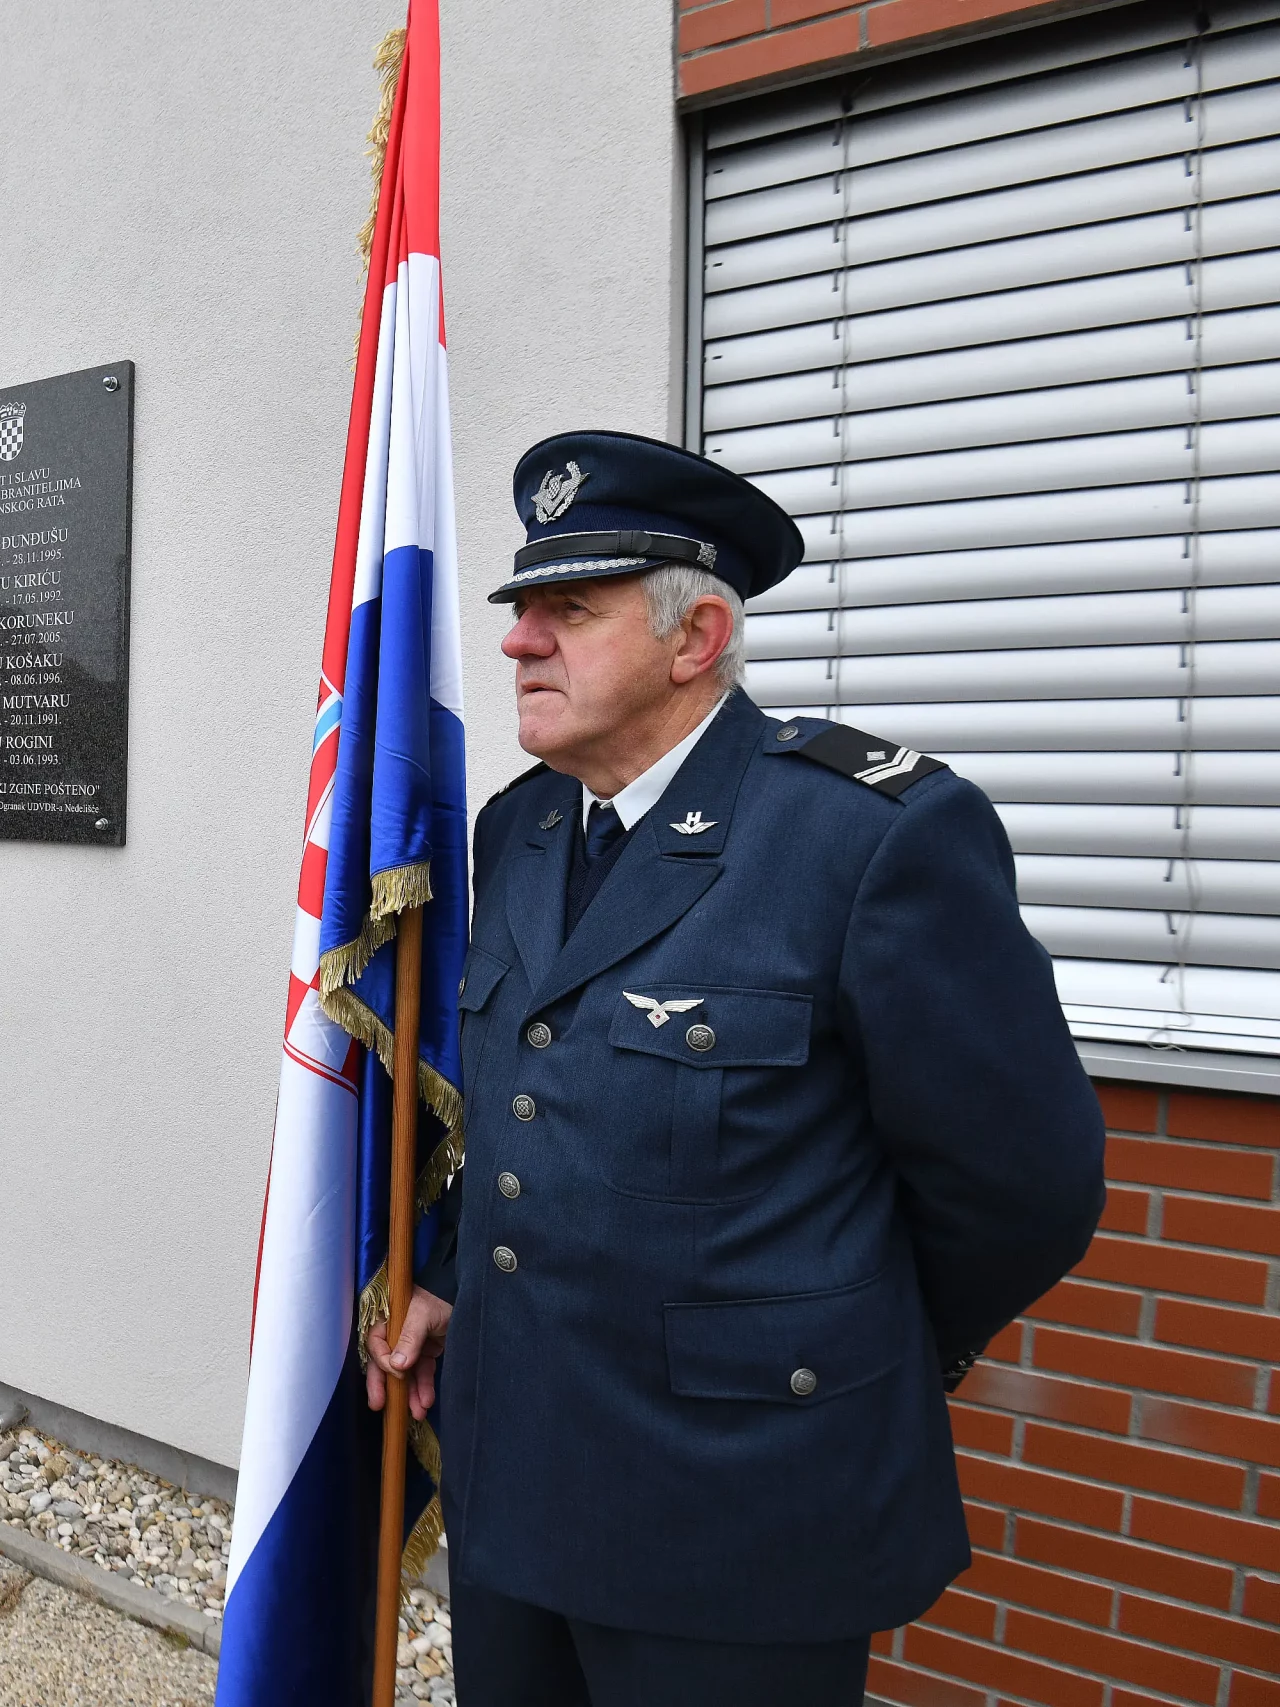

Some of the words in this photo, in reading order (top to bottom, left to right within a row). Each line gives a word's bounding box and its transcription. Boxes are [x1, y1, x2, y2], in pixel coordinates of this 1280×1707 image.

[14, 468, 50, 484] SLAVU
[0, 477, 82, 500] BRANITELJIMA
[36, 494, 66, 508] RATA
[2, 526, 68, 550] ĐUNĐUŠU
[12, 548, 65, 565] 28.11.1995.
[14, 568, 62, 589] KIRIĆU
[12, 590, 64, 606] 17.05.1992.
[11, 632, 63, 646] 27.07.2005.
[6, 652, 64, 670] KOŠAKU
[10, 672, 63, 686] 08.06.1996.
[2, 694, 70, 710] MUTVARU
[10, 714, 62, 726] 20.11.1991.
[6, 735, 53, 750] ROGINI
[9, 754, 62, 766] 03.06.1993.
[9, 782, 42, 794] ZGINE
[44, 781, 100, 796] POŠTENO"
[27, 802, 63, 812] UDVDR-a
